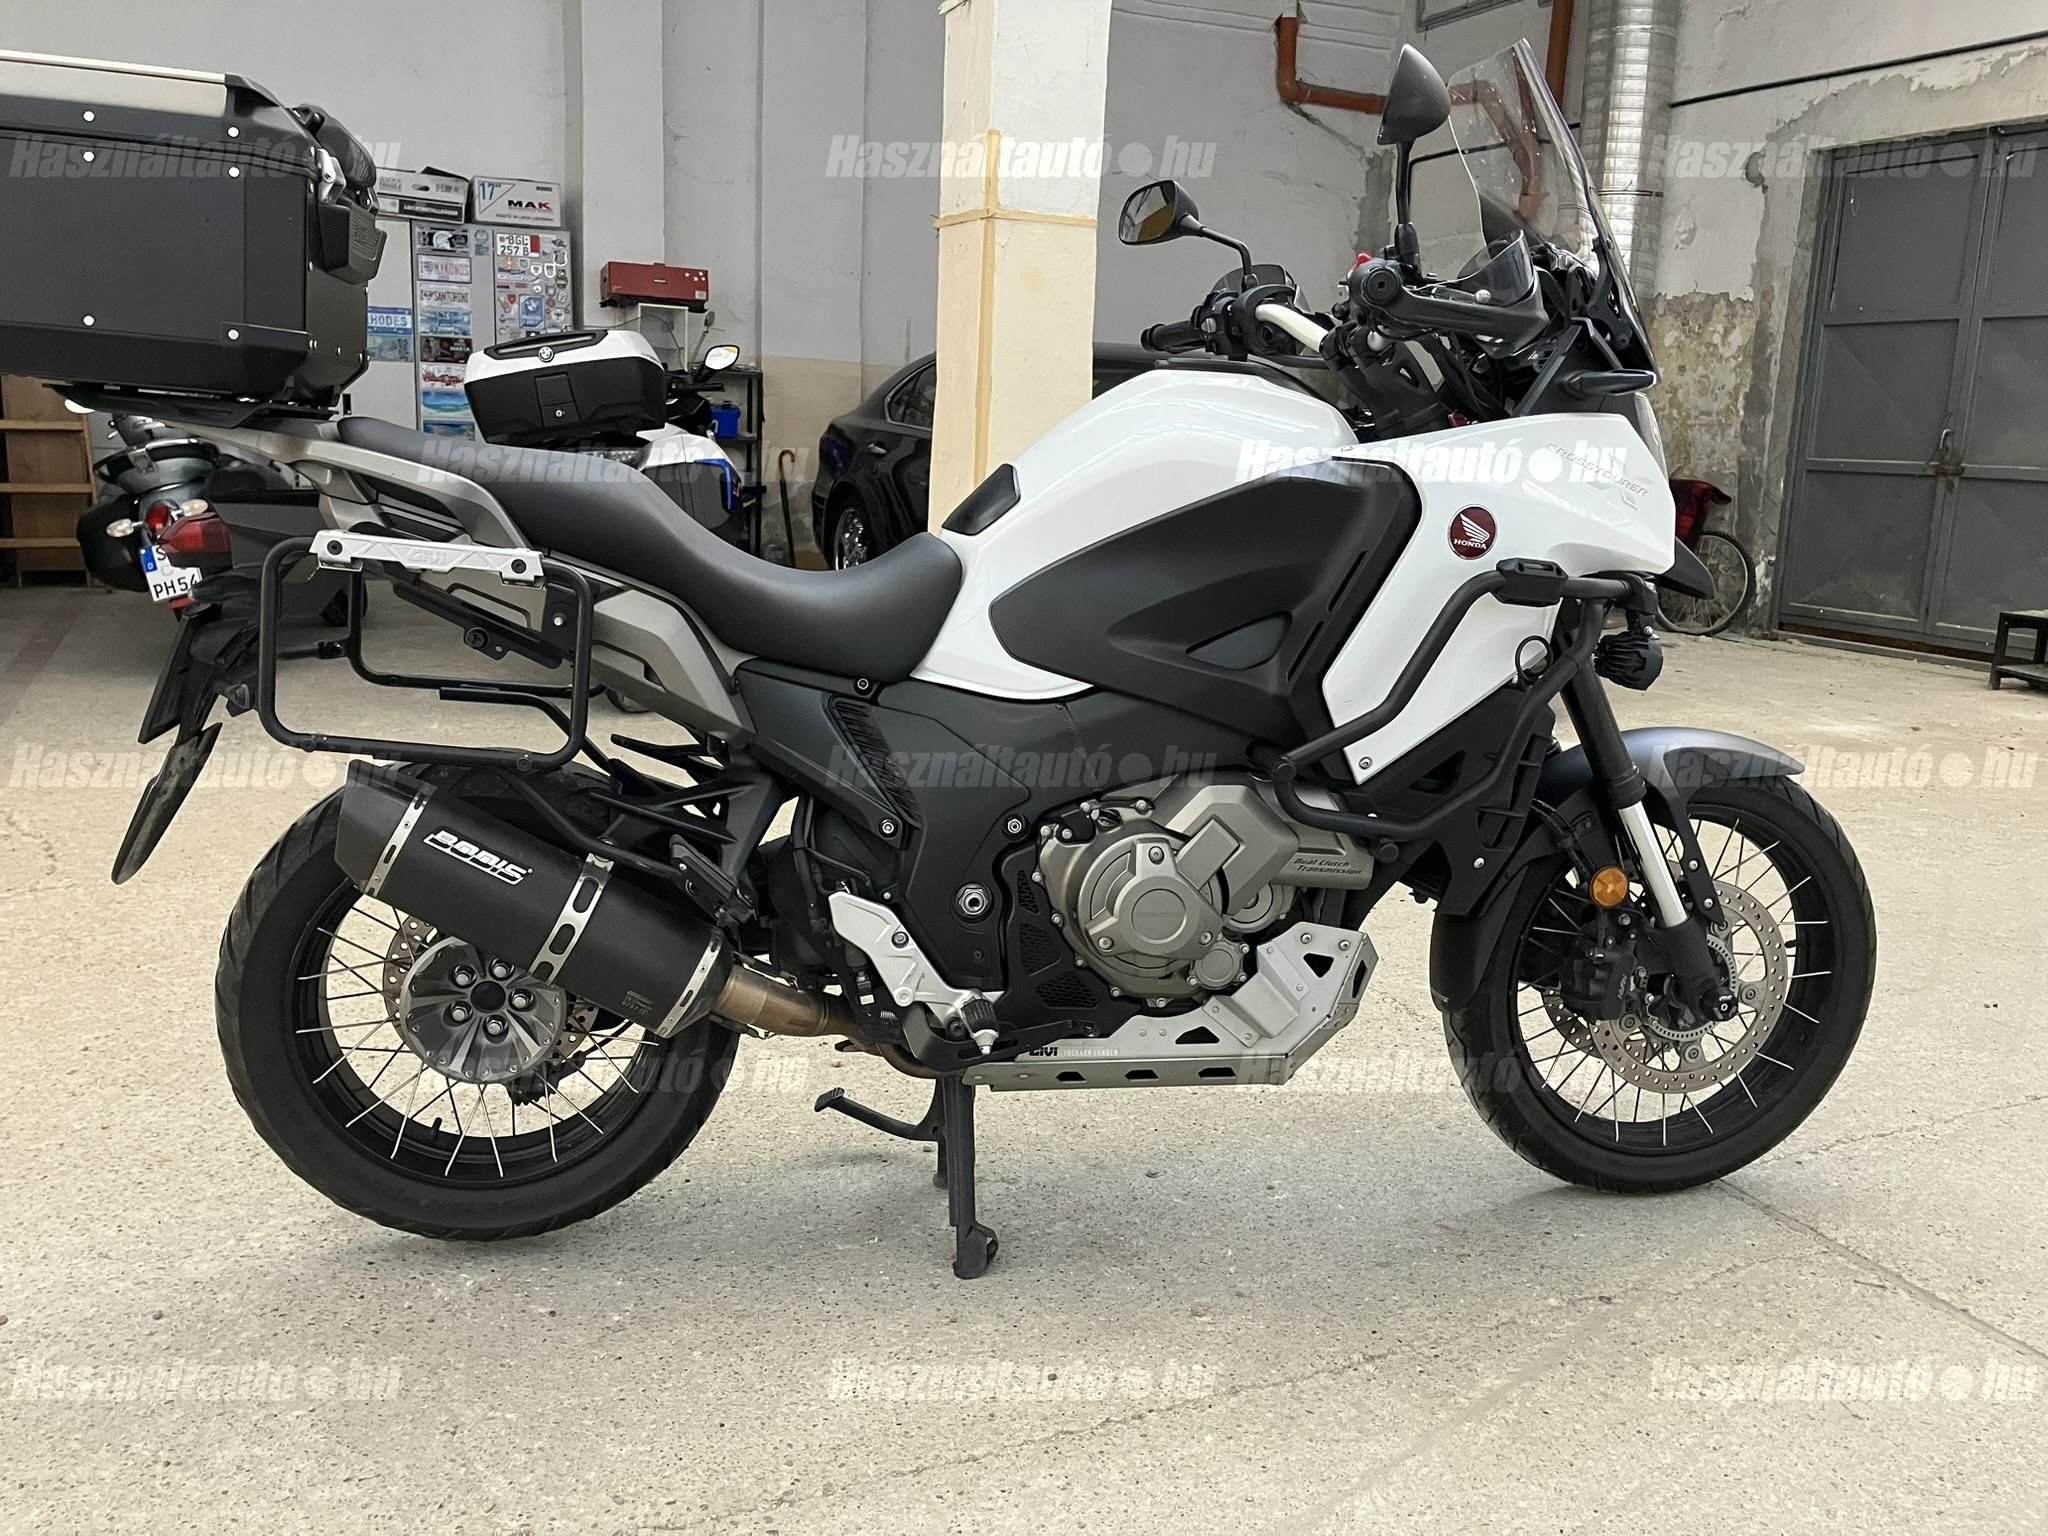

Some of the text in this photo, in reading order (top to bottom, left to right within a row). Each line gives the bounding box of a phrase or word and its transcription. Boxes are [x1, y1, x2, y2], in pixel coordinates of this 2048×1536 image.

[507, 199, 551, 210] MAK
[368, 314, 407, 326] HODES
[1546, 443, 1648, 496] CROSSTOURER
[1453, 538, 1487, 550] HONDA
[407, 549, 447, 565] GIVI
[153, 580, 176, 598] PH
[423, 830, 524, 885] BODIS
[1319, 859, 1349, 867] Clutch
[1297, 865, 1361, 875] Transmission
